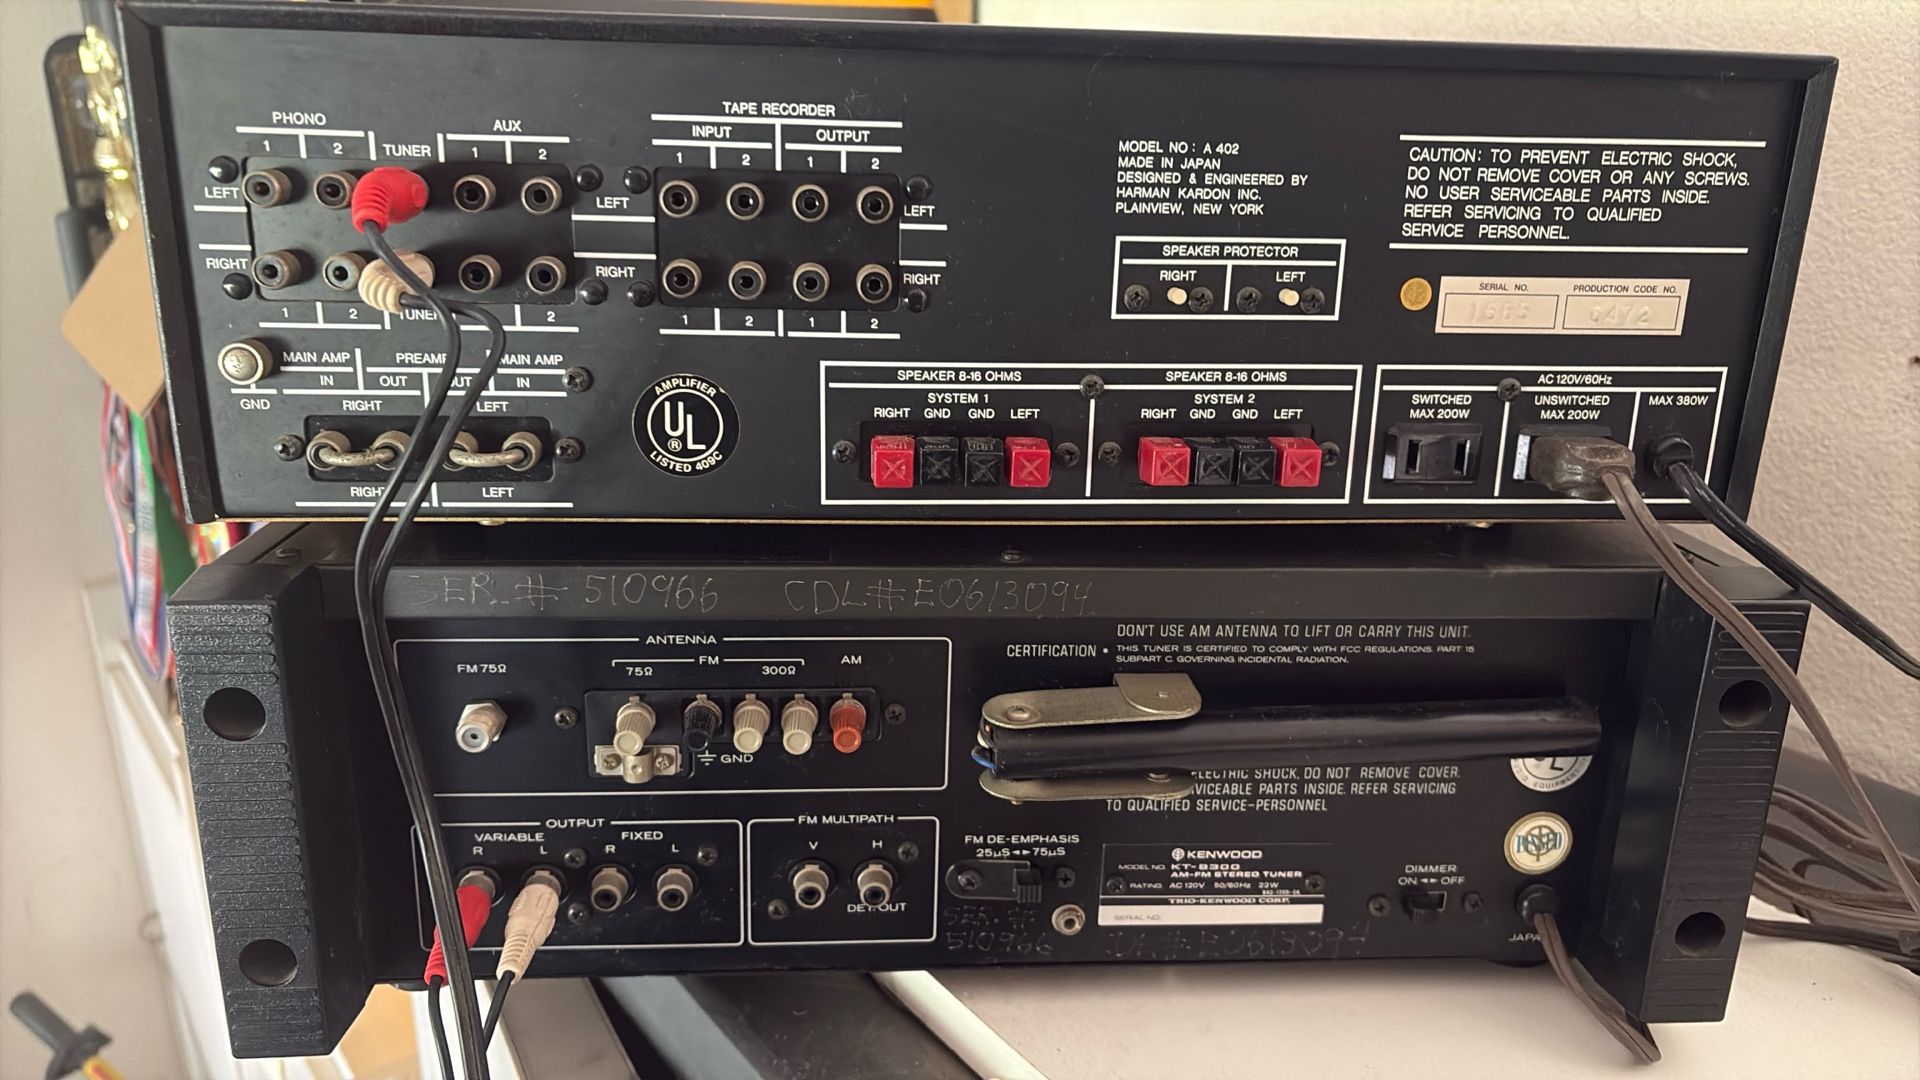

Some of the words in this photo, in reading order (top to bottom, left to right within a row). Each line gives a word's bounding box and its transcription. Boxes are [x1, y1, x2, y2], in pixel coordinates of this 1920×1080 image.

[722, 102, 757, 115] TAPE
[762, 104, 835, 117] RECORDER
[272, 112, 327, 126] PHONO
[493, 119, 522, 132] AUX
[692, 126, 732, 138] INPUT
[816, 130, 870, 143] OUTPUT
[383, 144, 431, 157] TUNER
[1118, 140, 1163, 153] MODEL
[1203, 143, 1212, 154] A
[1215, 143, 1240, 155] 402
[1118, 156, 1154, 168] MADE
[1161, 157, 1173, 169] IN
[1180, 158, 1221, 170] JAPAN
[1409, 147, 1482, 163] CAUTION:
[1491, 149, 1512, 164] TO
[1520, 150, 1589, 165] PREVENT
[1601, 151, 1673, 166] ELECTRIC
[1682, 153, 1738, 168] SHOCK,
[1117, 172, 1181, 184] DESIGNED
[1189, 173, 1197, 184] &
[1205, 173, 1284, 186] ENGINEERED
[1291, 175, 1308, 186] BY
[1407, 166, 1430, 180] DO
[1438, 168, 1472, 182] NOT
[1476, 168, 1540, 183] REMOVE
[1548, 169, 1601, 184] COVER
[1610, 171, 1632, 184] OR
[1642, 171, 1675, 185] ANY
[1684, 172, 1750, 187] SCREWS.
[204, 187, 239, 200] LEFT
[1116, 187, 1170, 198] HARMAN
[1178, 188, 1230, 200] KARDON
[1237, 189, 1262, 200] INC.
[1405, 185, 1428, 199] NO
[1439, 186, 1479, 200] USER
[1490, 187, 1591, 202] SERVICEABLE
[1602, 189, 1651, 203] PARTS
[1661, 190, 1710, 204] INSIDE.
[1115, 202, 1185, 216] PLAINVIEW,
[1193, 204, 1222, 214] NEW
[1230, 204, 1264, 215] YORK
[1404, 204, 1452, 219] REFER
[1464, 205, 1541, 220] SERVICING
[1554, 207, 1575, 221] TO
[1586, 207, 1662, 222] QUALIFIED
[1401, 223, 1464, 238] SERVICE
[1478, 225, 1570, 240] PERSONNEL.
[1162, 245, 1220, 257] SPEAKER
[1223, 246, 1298, 258] PROTECTOR
[206, 257, 248, 270] RIGHT
[1479, 282, 1508, 291] SERIAL
[1514, 284, 1529, 292] NO.
[1573, 285, 1629, 293] PRODUCTION
[1633, 285, 1657, 293] CODE
[1663, 286, 1678, 294] NO.
[283, 351, 317, 363] MAIN
[321, 352, 351, 363] AMP
[379, 376, 408, 387] OUT
[897, 370, 956, 382] SPEAKER
[959, 370, 982, 382] 8-16
[984, 370, 1022, 382] OHMS
[1537, 374, 1554, 385] AC
[1556, 374, 1612, 385] 120V/60Hz
[654, 378, 717, 397] AMPLIFIER
[240, 399, 270, 410] GND
[927, 393, 977, 404] SYSTEM
[1411, 394, 1472, 405] SWITCHED
[1534, 395, 1610, 406] UNSWITCHED
[1649, 395, 1674, 406] MAX
[1676, 395, 1708, 406] 380W
[343, 400, 382, 412] RIGHT
[476, 401, 508, 412] LEFT
[1410, 408, 1435, 419] MAX
[1437, 408, 1470, 419] 200W
[664, 401, 706, 450] UL
[649, 450, 692, 473] LISTED
[695, 450, 723, 471] 409C
[585, 573, 718, 613] 510966
[1117, 624, 1155, 637] DON'T
[1160, 625, 1185, 637] USE
[1189, 625, 1210, 637] AM
[1215, 625, 1278, 637] ANTENNA
[1284, 625, 1299, 637] TO
[1304, 625, 1331, 638] LIFT
[1335, 625, 1352, 638] OR
[1358, 625, 1402, 638] CARRY
[1407, 625, 1434, 638] THIS
[1439, 625, 1471, 638] UNIT.
[645, 635, 717, 645] ANTENNA
[1006, 644, 1097, 657] CERTIFICATION
[1116, 644, 1138, 652] THIS
[1195, 645, 1247, 653] CERTIFIED
[1269, 645, 1308, 653] COMPLY
[1312, 645, 1336, 653] WITH
[1340, 645, 1361, 653] FCC
[699, 655, 719, 665] FM
[841, 655, 861, 665] AM
[1116, 655, 1161, 663] SUBPART
[1177, 655, 1235, 663] GOVERNING
[1238, 655, 1293, 663] INCIDENTAL
[626, 666, 653, 676] 75Ω
[762, 665, 796, 676] 300Ω
[720, 753, 753, 764] GND
[1304, 767, 1321, 779] DO
[1326, 767, 1351, 779] NOT
[1360, 767, 1410, 779] REMOVE
[1419, 766, 1461, 778] COVER.
[1259, 783, 1297, 795] PARTS
[1304, 783, 1346, 794] INSIDE.
[1350, 782, 1388, 794] REFER
[1392, 782, 1457, 794] SERVICING
[1106, 799, 1122, 811] TO
[1127, 799, 1190, 811] QUALIFIED
[1196, 799, 1328, 811] SERVICE-PERSONNEL
[545, 818, 605, 828] OUTPUT
[798, 815, 818, 824] FM
[821, 814, 894, 824] MULTIPATH
[474, 832, 545, 843] VARIABLE
[621, 831, 664, 841] FIXED
[964, 835, 985, 844] FM
[987, 834, 1079, 844] DE-EMPHASIS
[1187, 850, 1263, 859] KENWOOD
[1405, 864, 1457, 873] DIMMER
[1398, 877, 1417, 886] ON
[1440, 876, 1465, 885] OFF
[1509, 933, 1542, 942] JAPA
